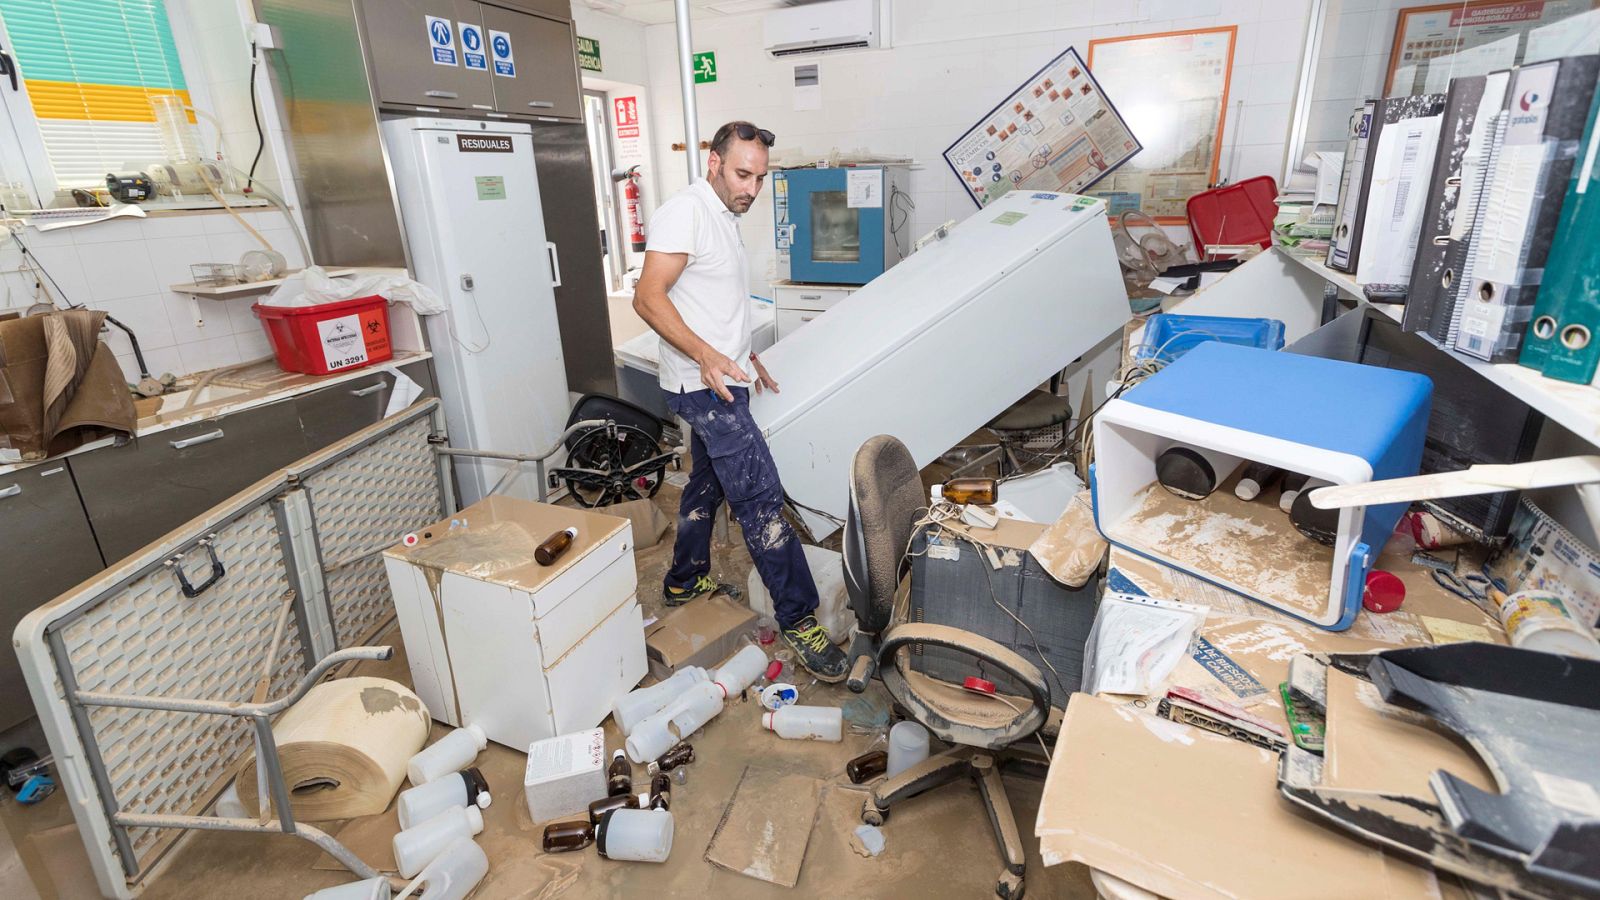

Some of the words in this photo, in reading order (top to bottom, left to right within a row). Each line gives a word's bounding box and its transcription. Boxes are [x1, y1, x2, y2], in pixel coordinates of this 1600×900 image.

[578, 54, 602, 70] ERGENCIA
[461, 139, 510, 150] RESIDUALES
[330, 360, 343, 369] UN
[345, 354, 365, 365] 3291
[1200, 654, 1210, 662] Y
[1203, 647, 1220, 661] DE
